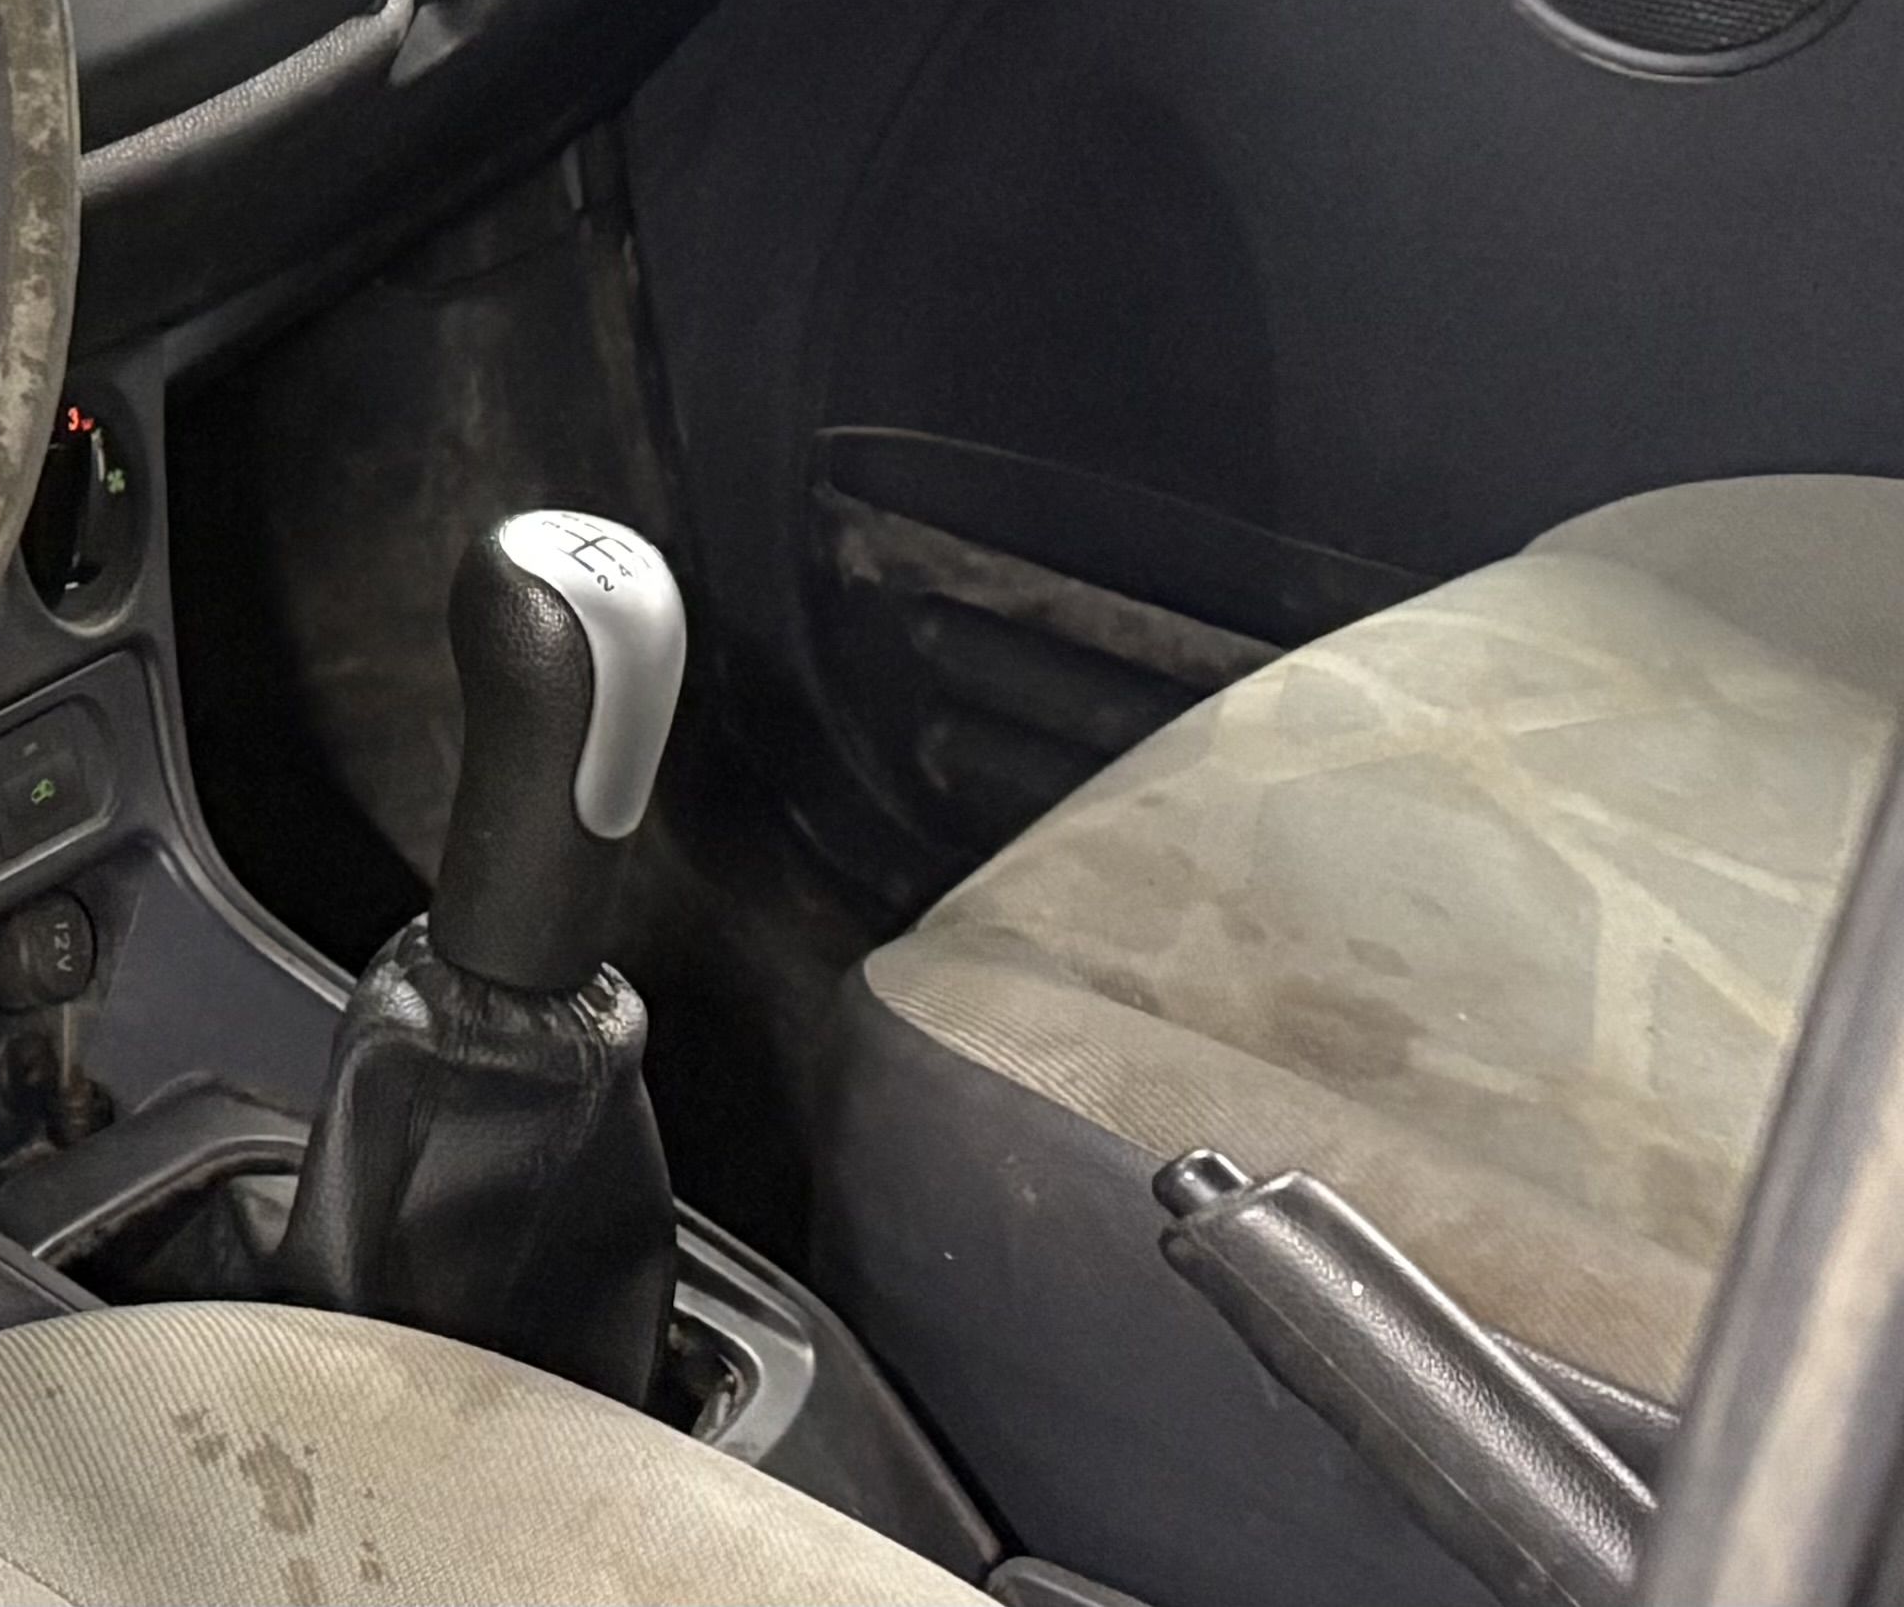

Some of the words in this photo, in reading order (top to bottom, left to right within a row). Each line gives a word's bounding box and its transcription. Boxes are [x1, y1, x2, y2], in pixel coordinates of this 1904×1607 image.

[67, 406, 80, 431] 3
[596, 573, 615, 592] 2
[52, 921, 73, 973] 12V
